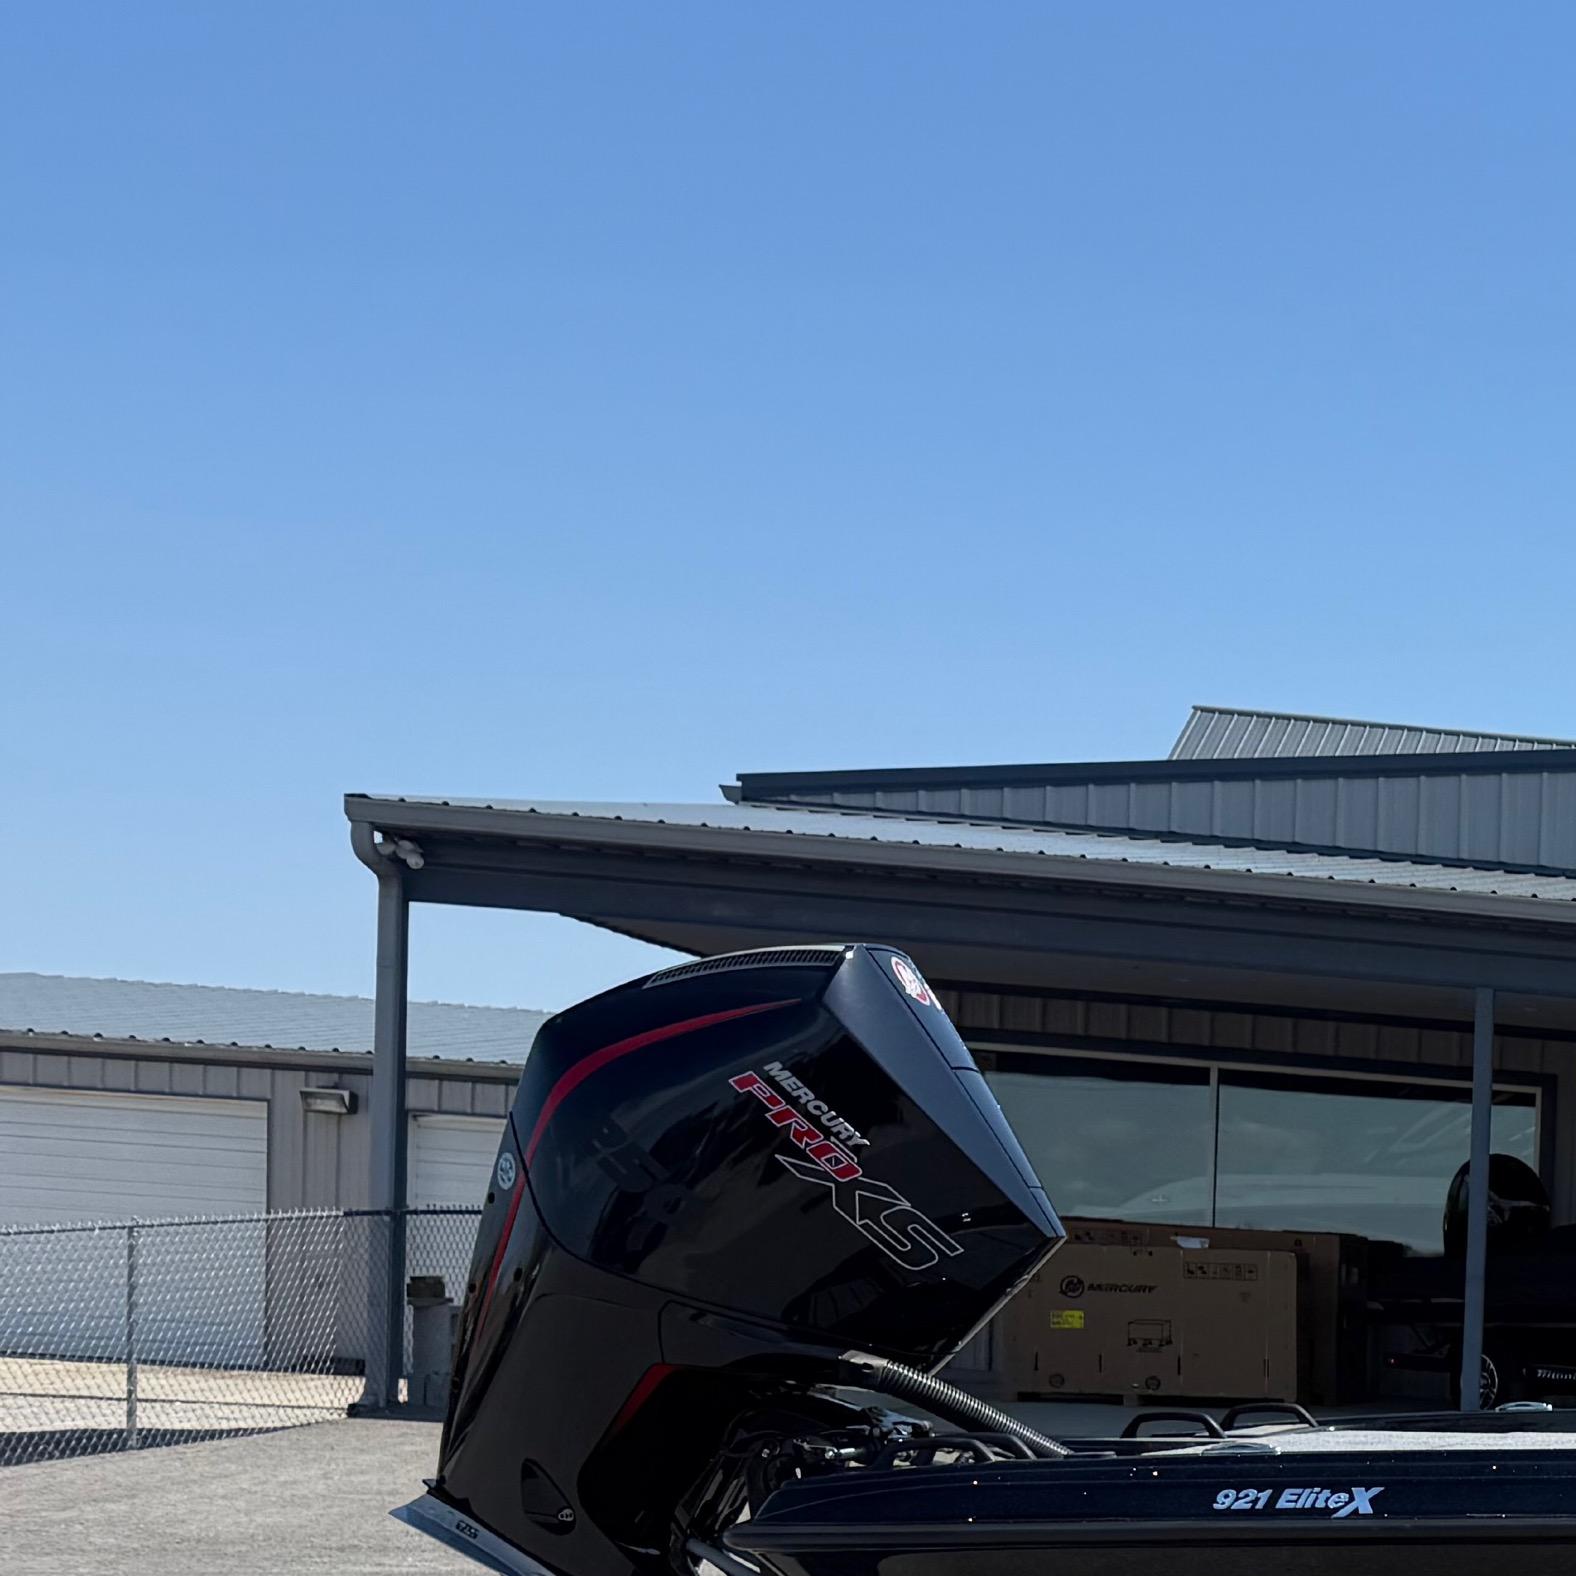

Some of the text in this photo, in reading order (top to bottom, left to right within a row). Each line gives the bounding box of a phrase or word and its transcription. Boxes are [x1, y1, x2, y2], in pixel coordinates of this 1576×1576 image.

[728, 1071, 863, 1182] PRO
[763, 1061, 871, 1147] MERCURY
[775, 1136, 964, 1270] XS
[1213, 1489, 1273, 1510] 921
